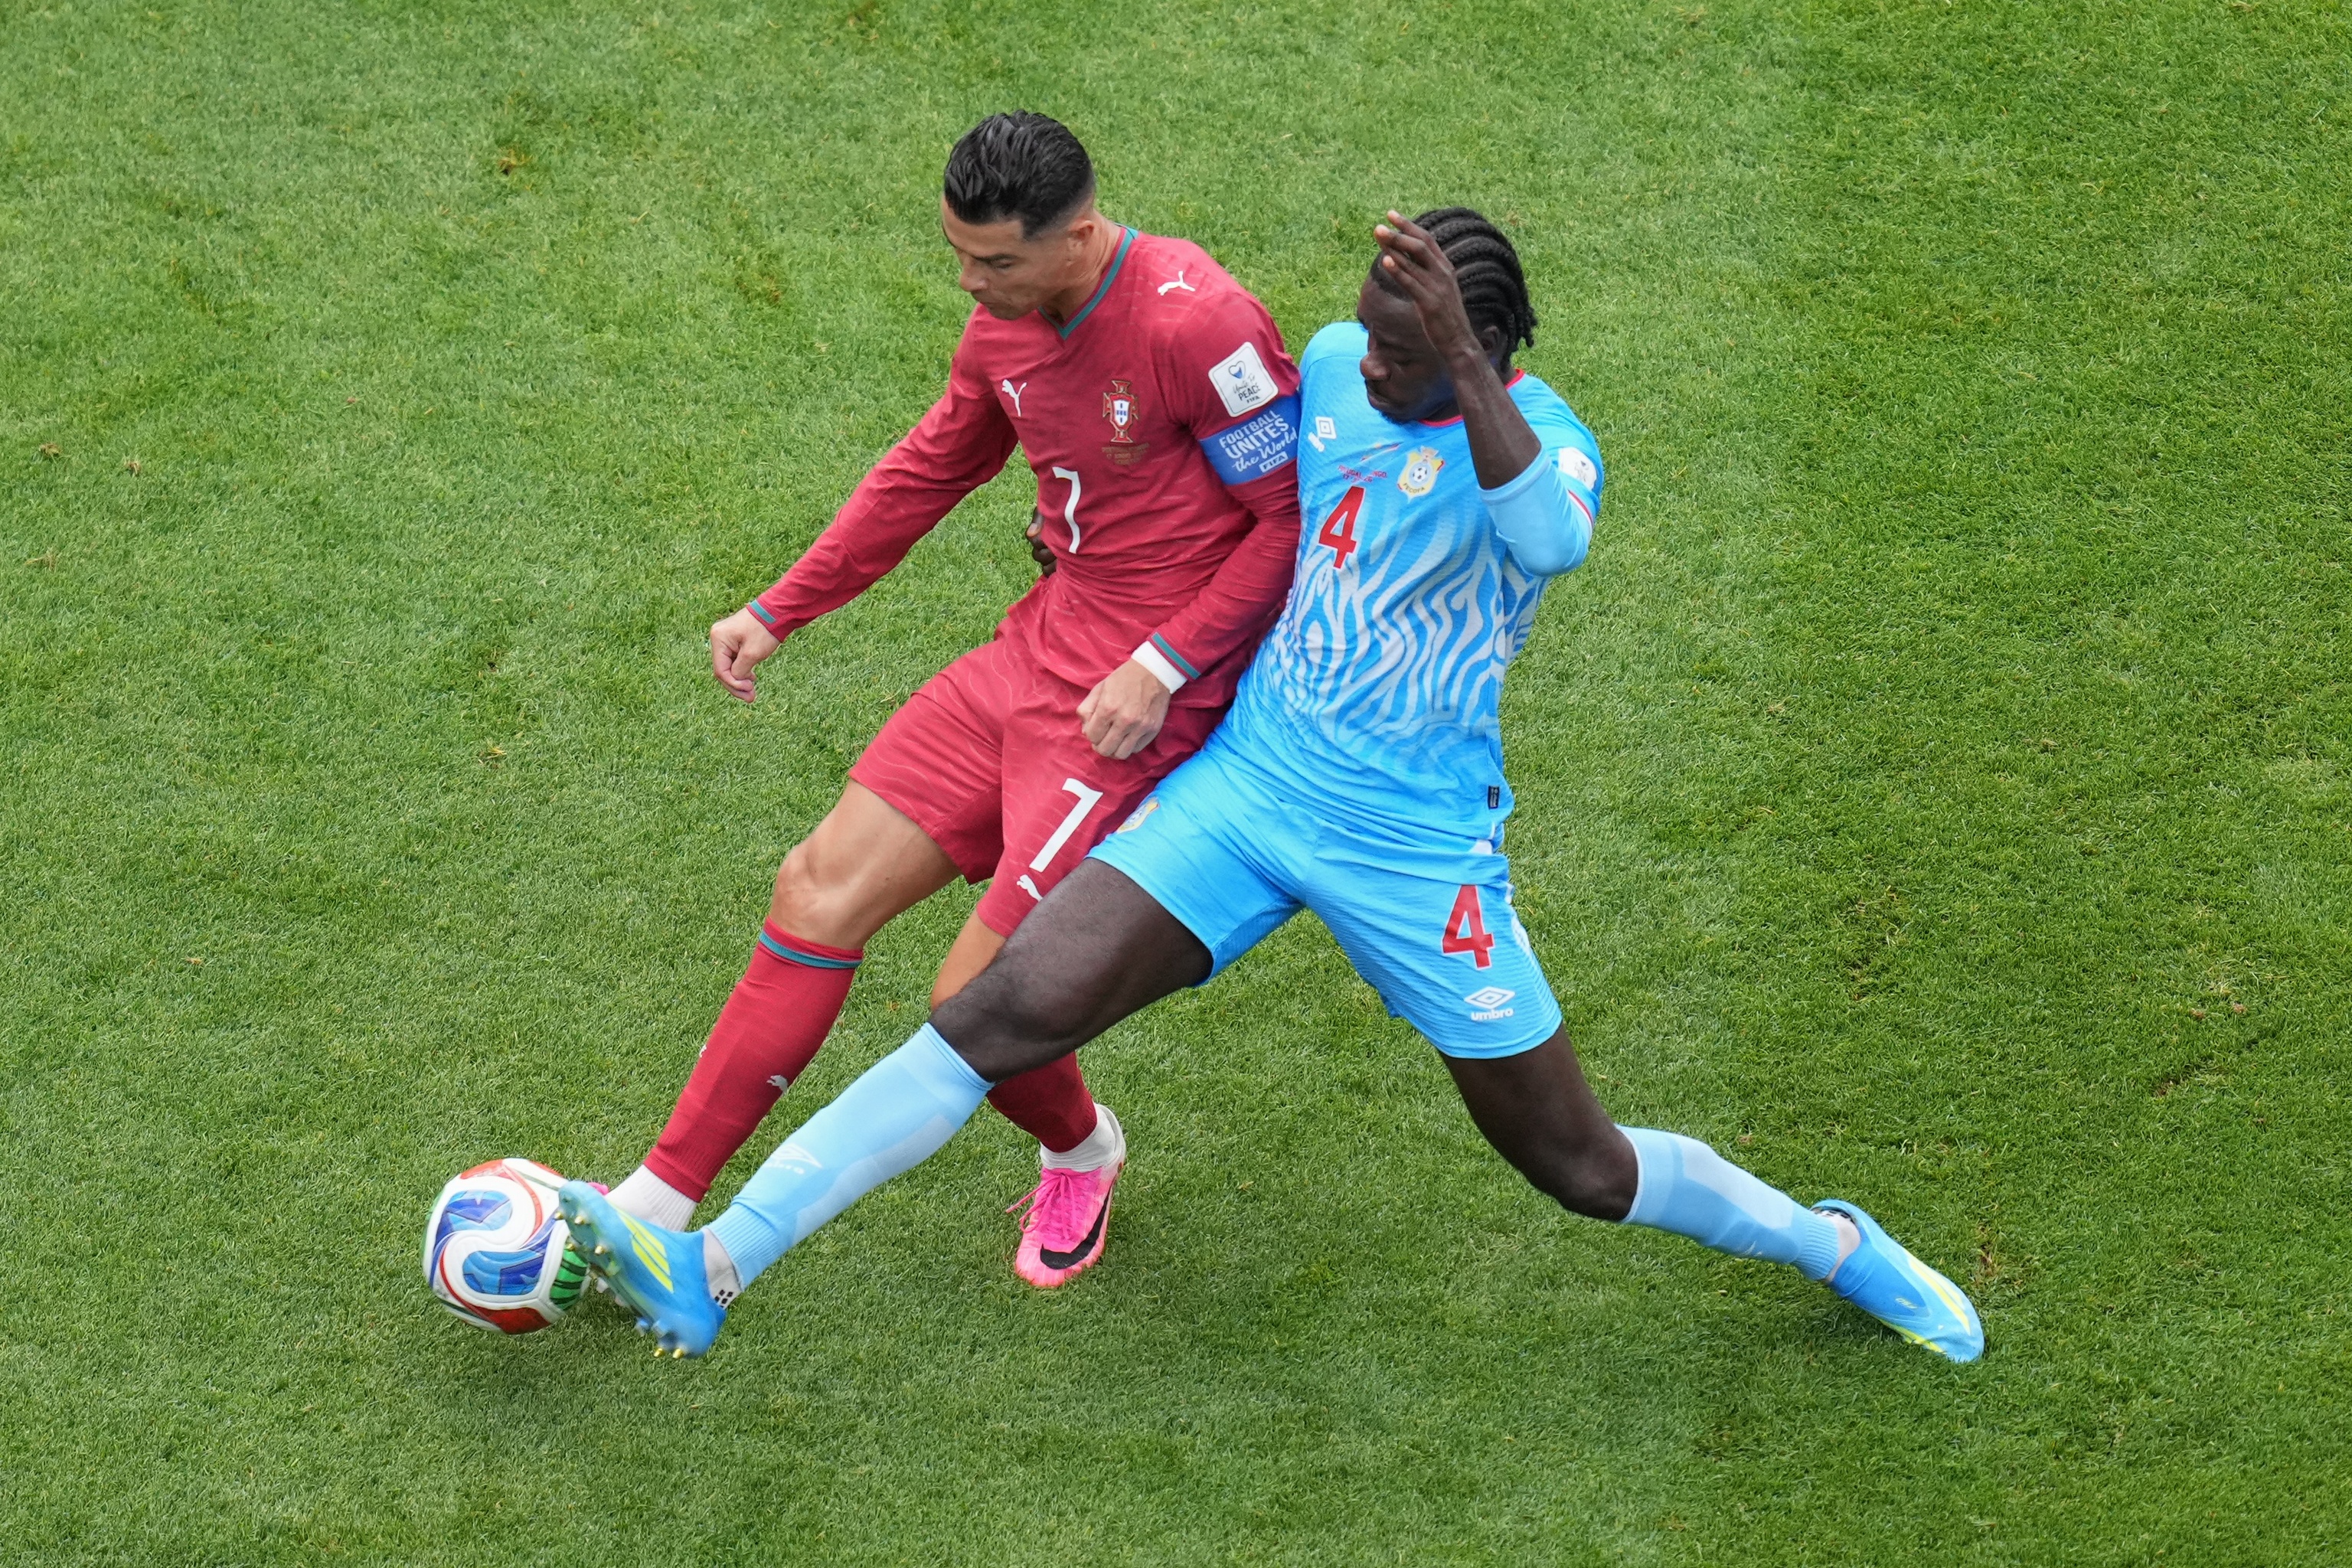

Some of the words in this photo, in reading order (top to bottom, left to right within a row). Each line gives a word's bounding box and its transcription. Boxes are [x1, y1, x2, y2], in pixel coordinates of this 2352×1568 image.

[1237, 383, 1261, 401] PEACE
[1219, 410, 1280, 449] FOOTBALL
[1225, 417, 1289, 459] UNITES
[1231, 456, 1259, 472] the
[1257, 426, 1298, 459] World
[1262, 454, 1287, 471] FIFA
[1052, 466, 1081, 554] 7
[1318, 485, 1365, 570] 4
[1028, 778, 1104, 873] 7
[1441, 884, 1495, 970] 4
[1470, 1008, 1514, 1022] umbro
